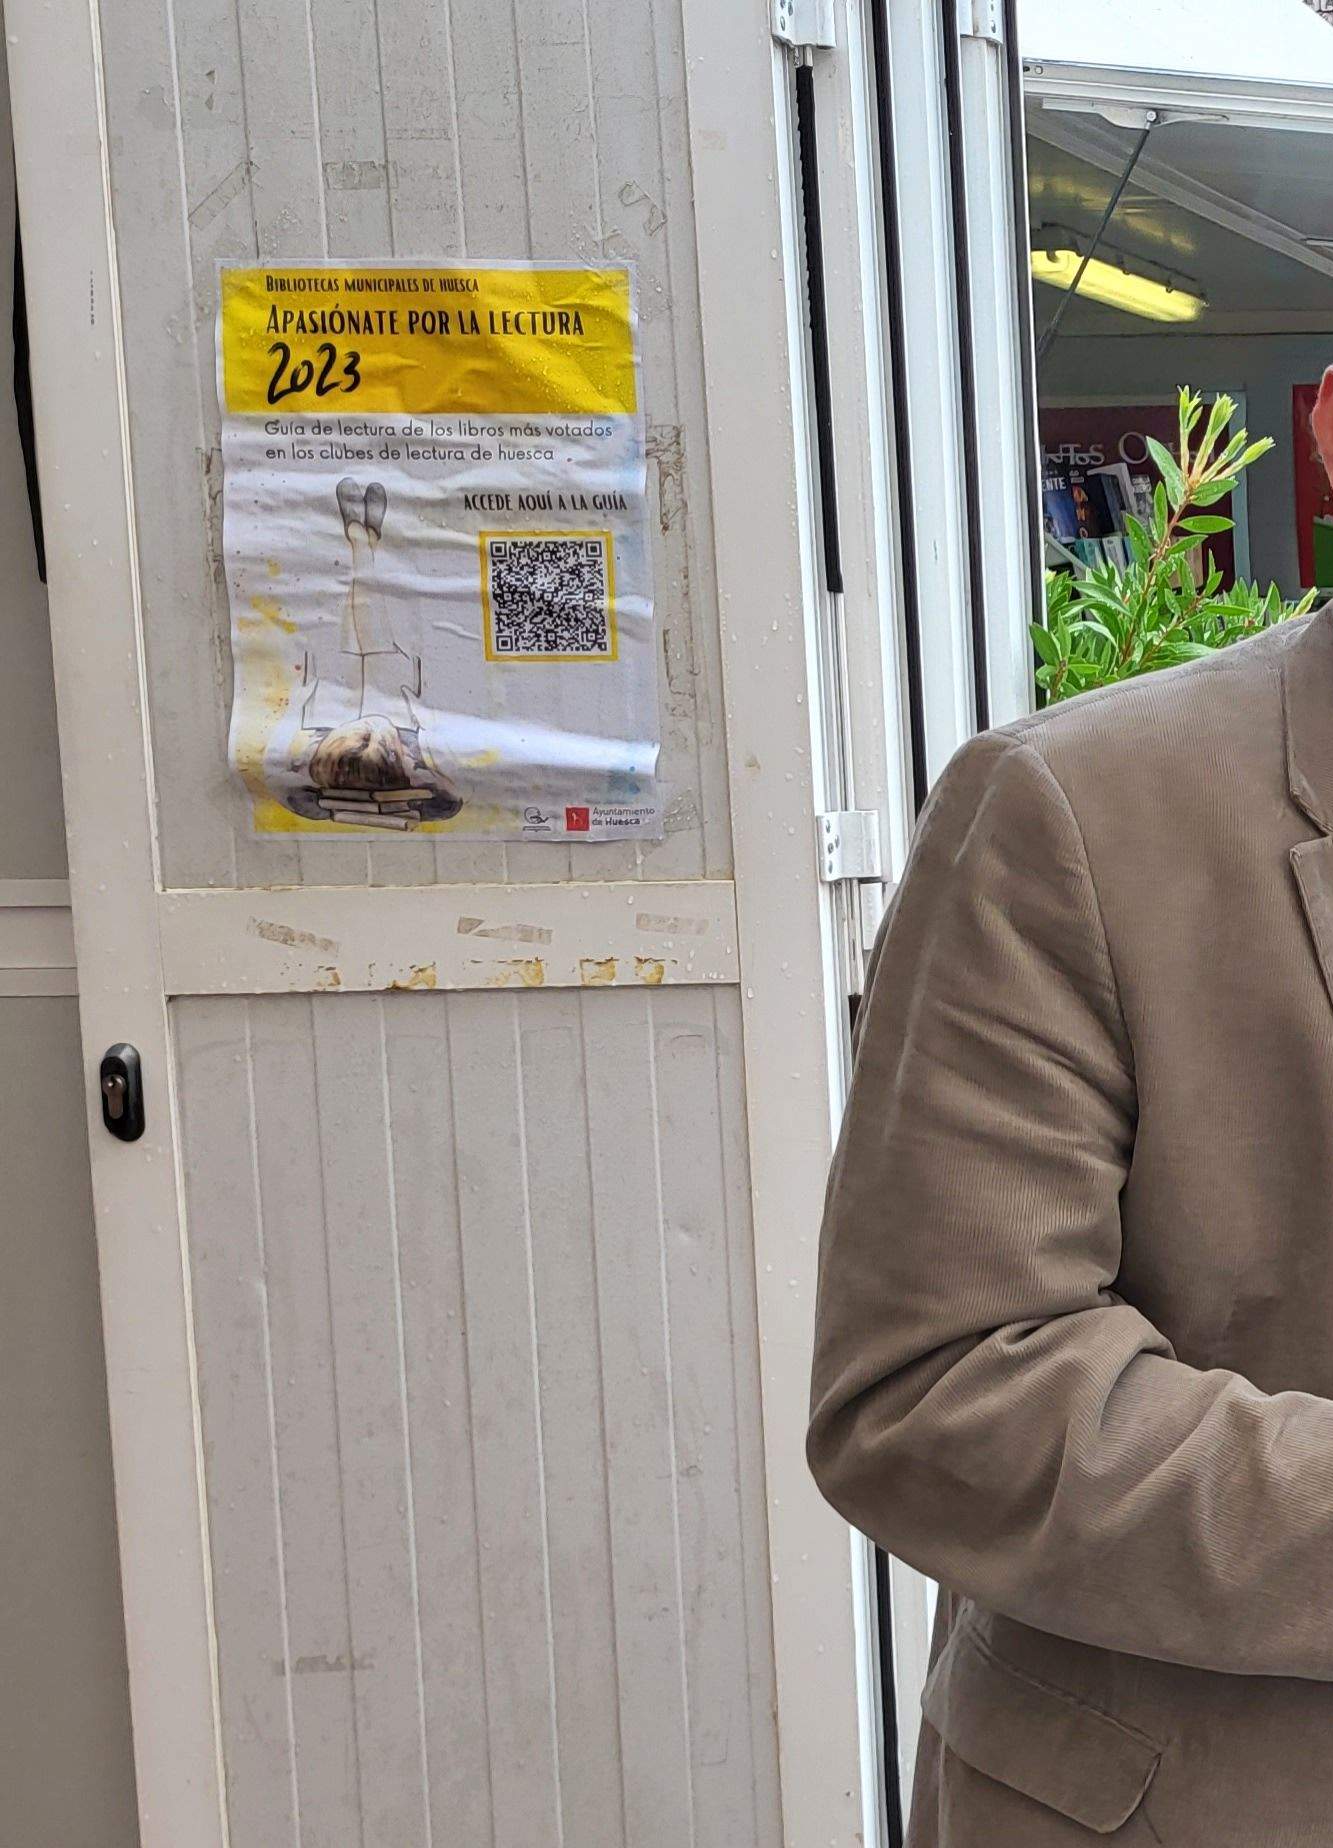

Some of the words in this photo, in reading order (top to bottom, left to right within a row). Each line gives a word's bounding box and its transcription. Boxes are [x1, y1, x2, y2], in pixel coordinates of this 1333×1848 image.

[344, 278, 419, 293] MUNICIPALES
[423, 279, 436, 292] DE
[439, 279, 479, 292] HUESCA
[266, 304, 399, 335] APASIÓNATE
[408, 310, 450, 335] POR
[459, 311, 480, 335] LA
[489, 311, 584, 335] LECTURA
[267, 342, 361, 405] 2023
[264, 419, 306, 437] Guía
[312, 419, 333, 436] de
[338, 420, 395, 437] lectura
[402, 420, 424, 437] de
[430, 420, 453, 437] los
[458, 420, 504, 438] libros
[509, 421, 541, 437] más
[545, 421, 612, 438] votados
[265, 447, 286, 461] en
[291, 443, 314, 460] los
[320, 443, 374, 460] clubes
[379, 443, 401, 461] de
[406, 443, 465, 461] lectura
[470, 443, 492, 461] de
[499, 443, 554, 461] huesca
[464, 494, 513, 511] ACCEDE
[518, 490, 553, 511] AQUÍ
[558, 494, 567, 511] A
[571, 494, 588, 511] LA
[592, 490, 628, 511] GUÍA
[592, 807, 655, 816] Ayuntamiento
[606, 817, 641, 826] Huesca
